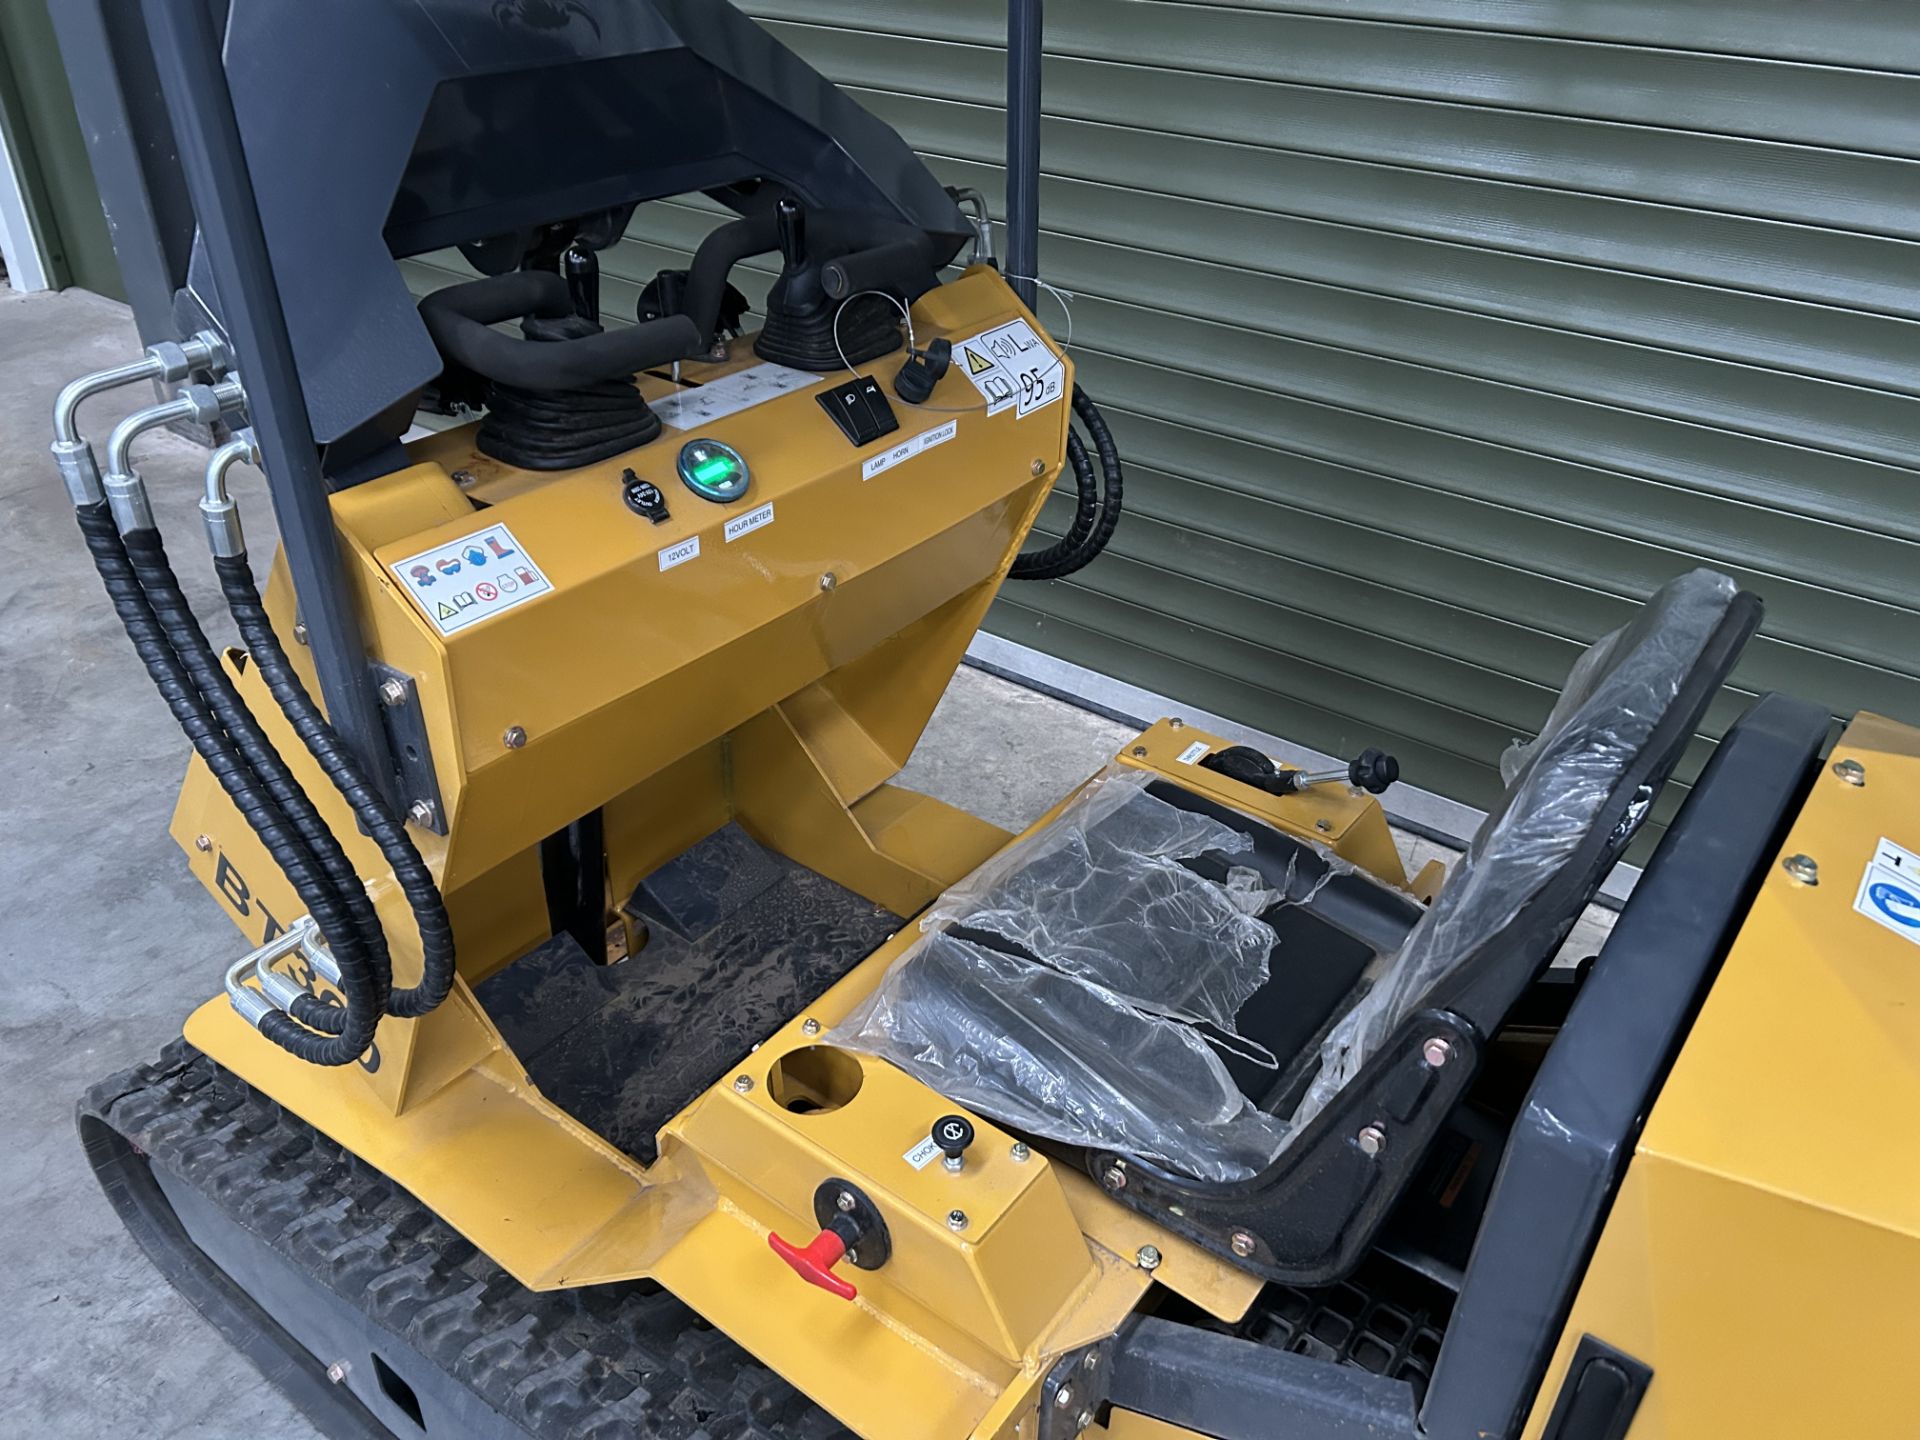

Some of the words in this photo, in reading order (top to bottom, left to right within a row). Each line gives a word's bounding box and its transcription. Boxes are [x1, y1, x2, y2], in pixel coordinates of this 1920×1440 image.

[1019, 367, 1045, 406] 95
[870, 457, 886, 471] LAMP
[892, 446, 909, 460] HORN
[728, 520, 749, 536] HOUR
[748, 508, 772, 526] METER
[667, 544, 695, 563] 12VOLT
[912, 1142, 937, 1163] CHOK
